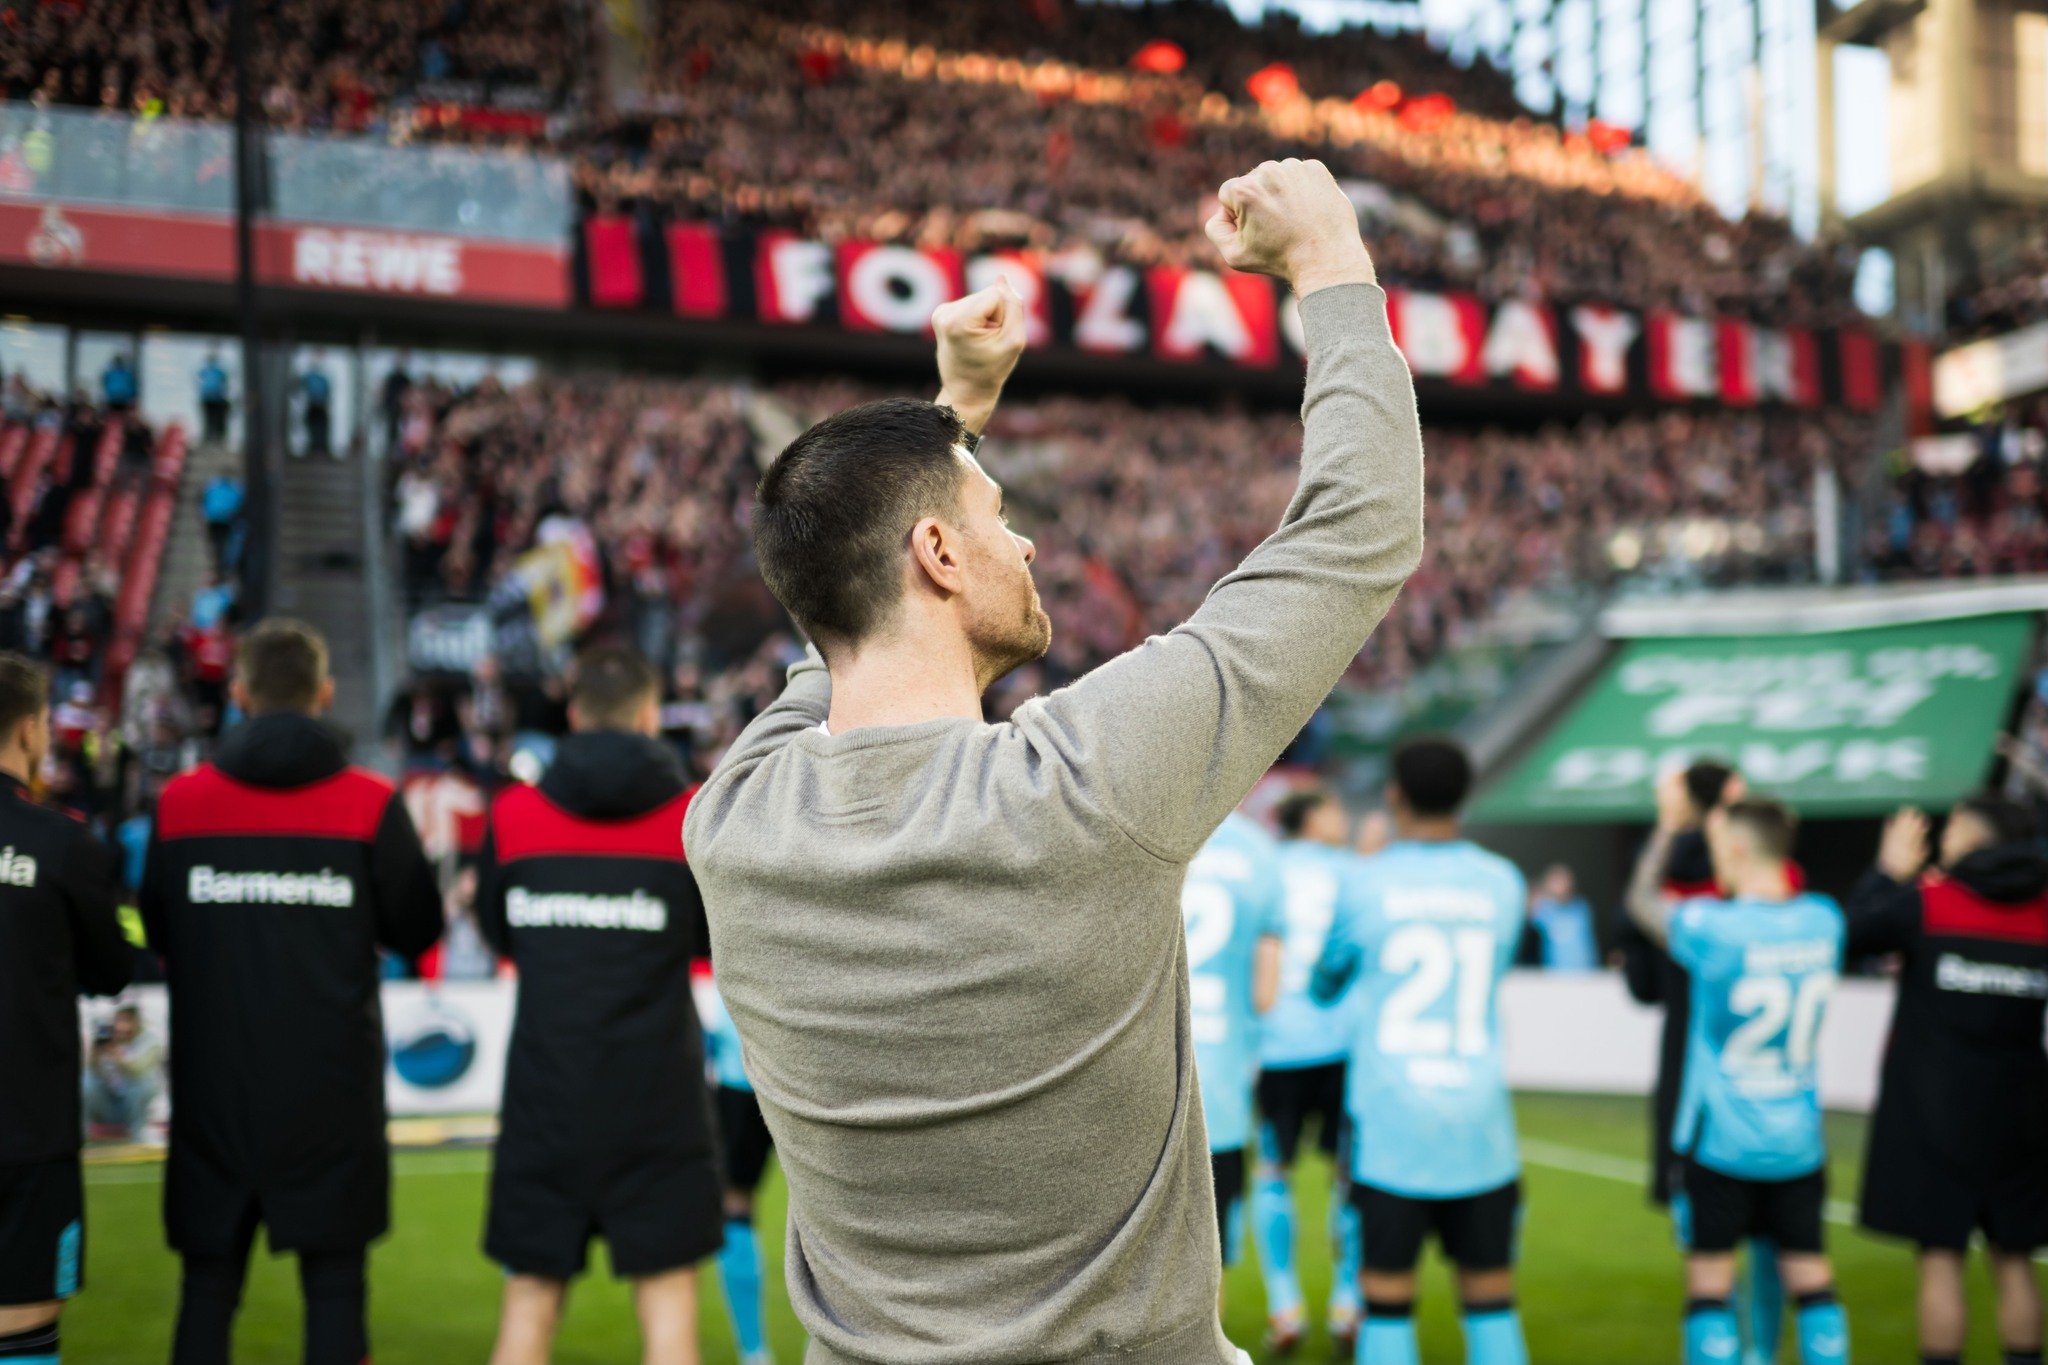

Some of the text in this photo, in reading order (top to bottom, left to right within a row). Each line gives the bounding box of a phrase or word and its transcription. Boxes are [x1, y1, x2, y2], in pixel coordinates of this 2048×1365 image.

[295, 228, 464, 295] REWE
[188, 865, 354, 907] Barmenia
[506, 886, 667, 931] Barmenia
[1379, 925, 1494, 1056] 21
